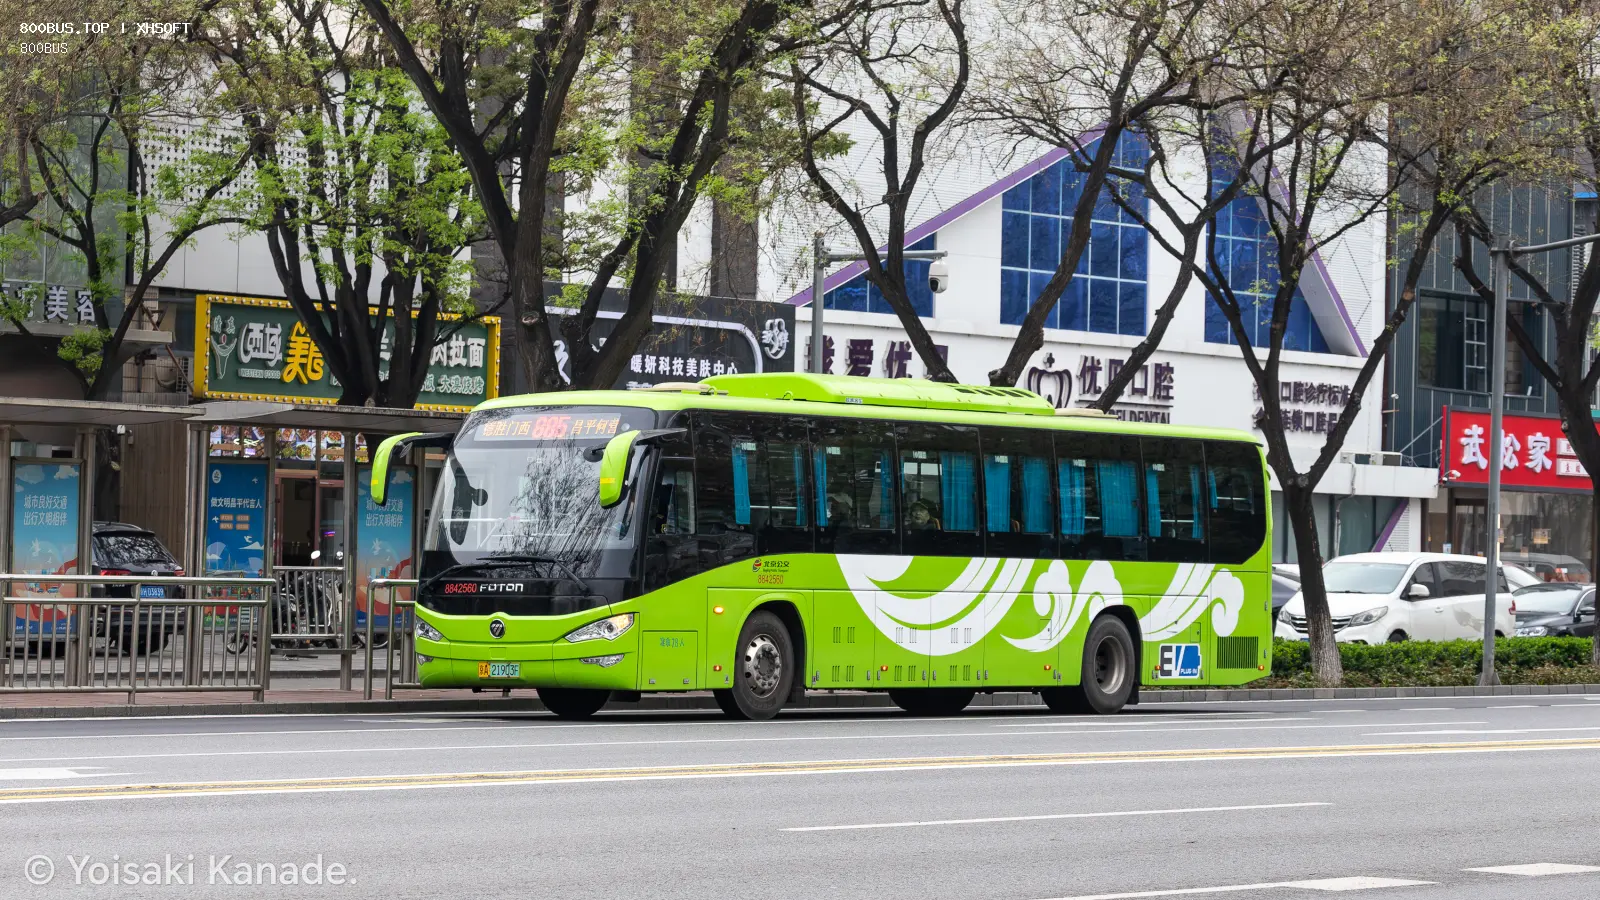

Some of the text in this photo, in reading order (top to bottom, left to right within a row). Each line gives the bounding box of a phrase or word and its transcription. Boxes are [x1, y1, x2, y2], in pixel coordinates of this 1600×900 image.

[1459, 424, 1552, 473] 武松家
[763, 560, 790, 568] 北京公交
[445, 583, 524, 594] 8842560 FOTON
